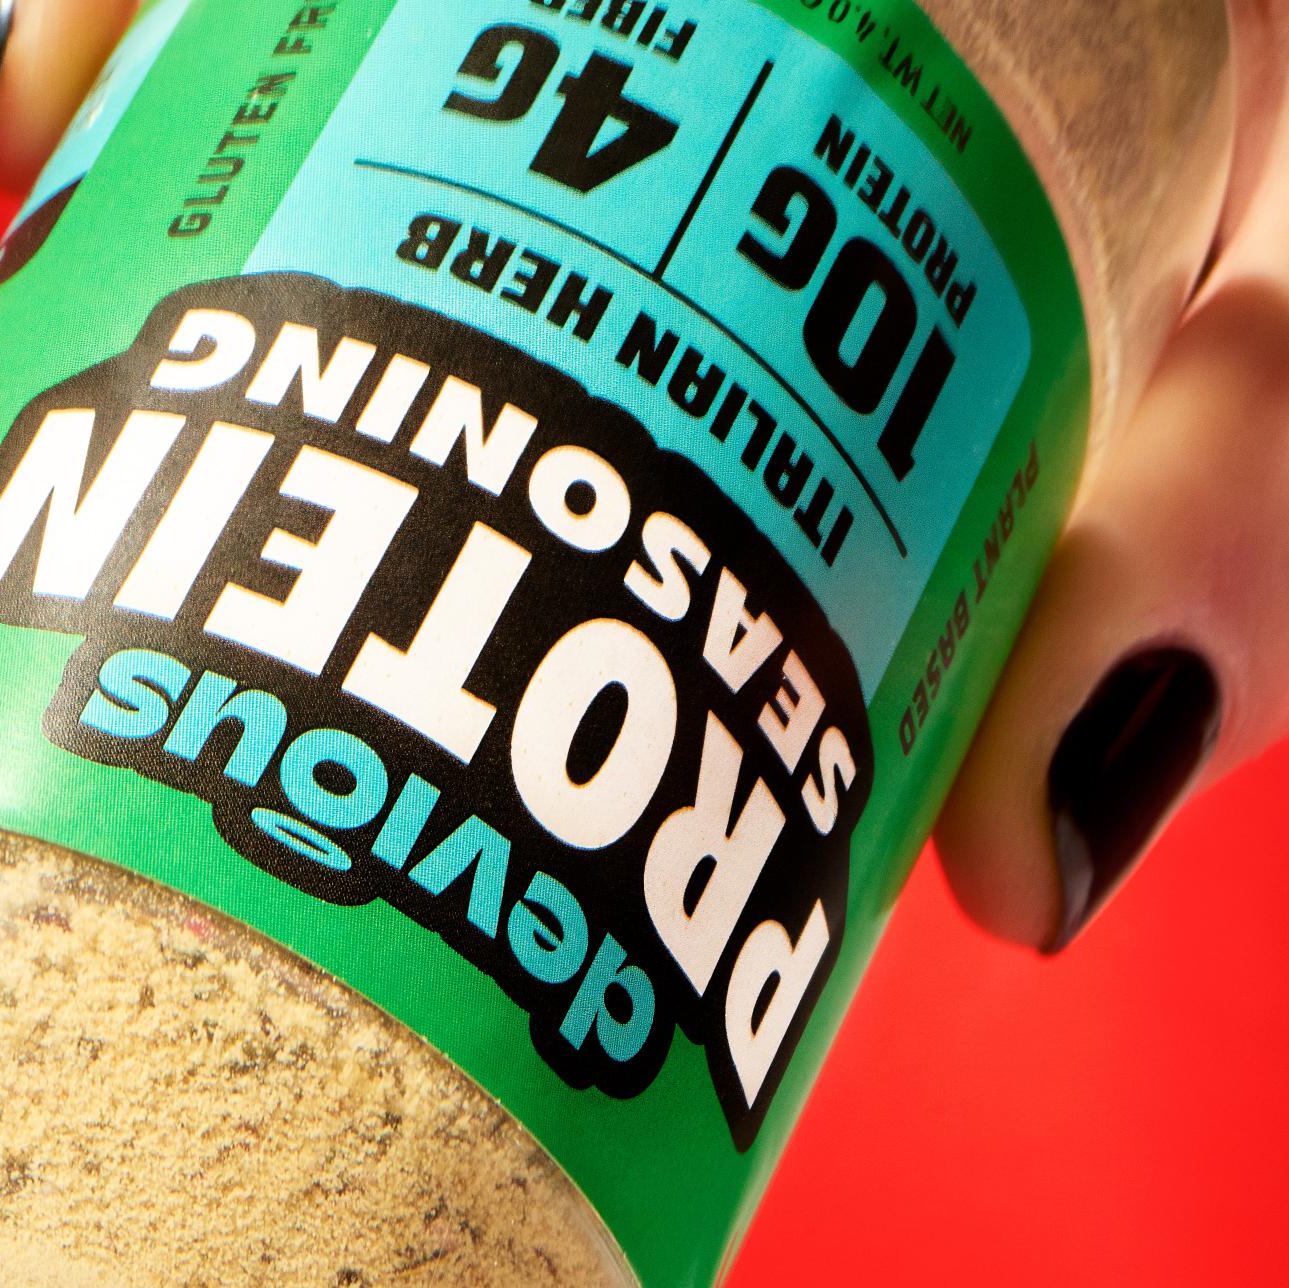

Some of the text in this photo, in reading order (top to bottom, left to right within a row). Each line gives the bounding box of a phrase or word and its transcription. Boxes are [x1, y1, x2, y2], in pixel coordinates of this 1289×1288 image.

[167, 71, 297, 238] GLUTEN
[441, 22, 680, 194] 4G
[814, 112, 978, 330] PROTEIN
[921, 84, 973, 154] NET
[396, 212, 855, 568] ITALIAN HERB
[736, 164, 957, 482] 10G
[150, 308, 856, 836] SEASONING
[898, 438, 1040, 758] PLANT BASED
[79, 648, 656, 1062] devious
